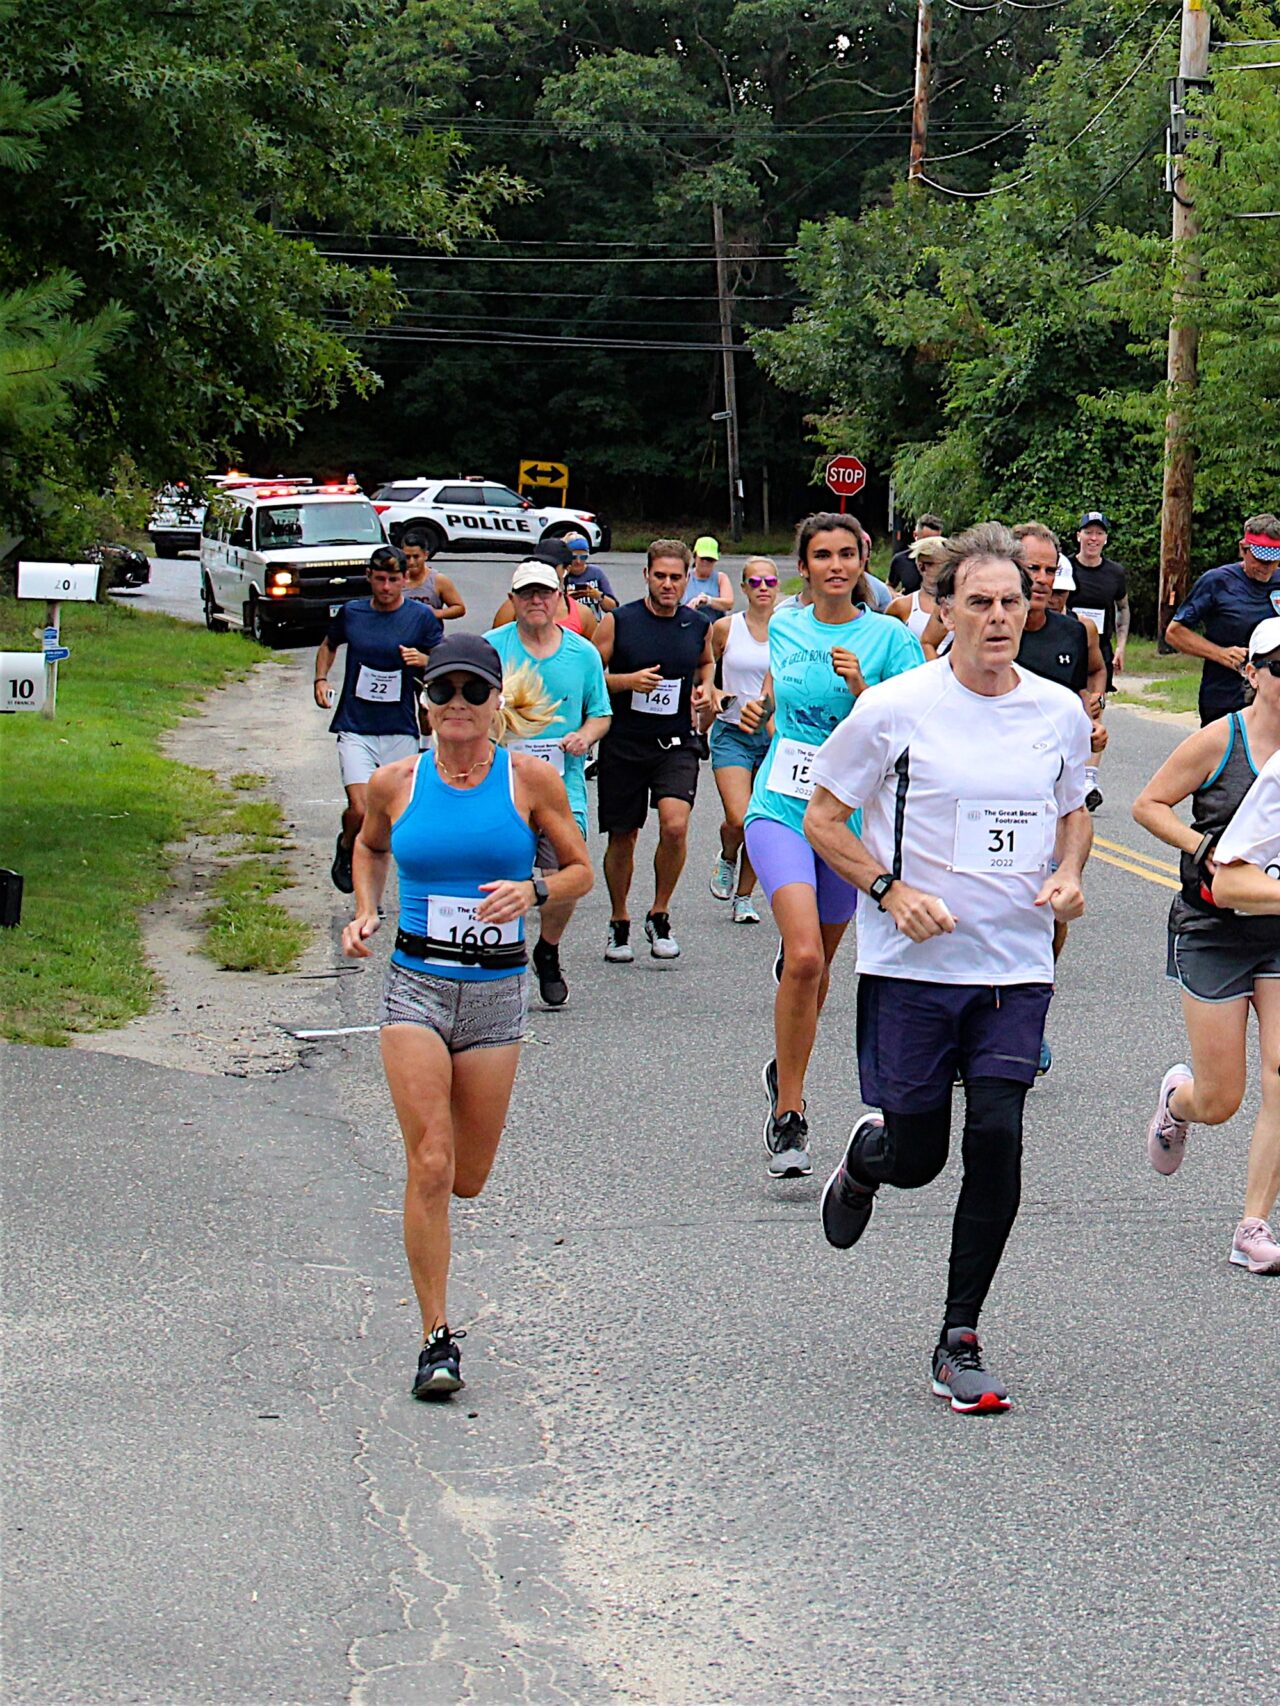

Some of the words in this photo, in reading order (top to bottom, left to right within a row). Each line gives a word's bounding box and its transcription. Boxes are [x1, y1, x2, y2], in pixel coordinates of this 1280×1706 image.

[829, 467, 863, 484] STOP
[446, 514, 531, 533] POLICE
[9, 679, 34, 698] 10
[369, 683, 388, 694] 22
[644, 692, 670, 705] 146
[792, 764, 818, 785] 15
[988, 829, 1014, 852] 31
[990, 859, 1013, 867] 2022
[449, 925, 502, 945] 160
